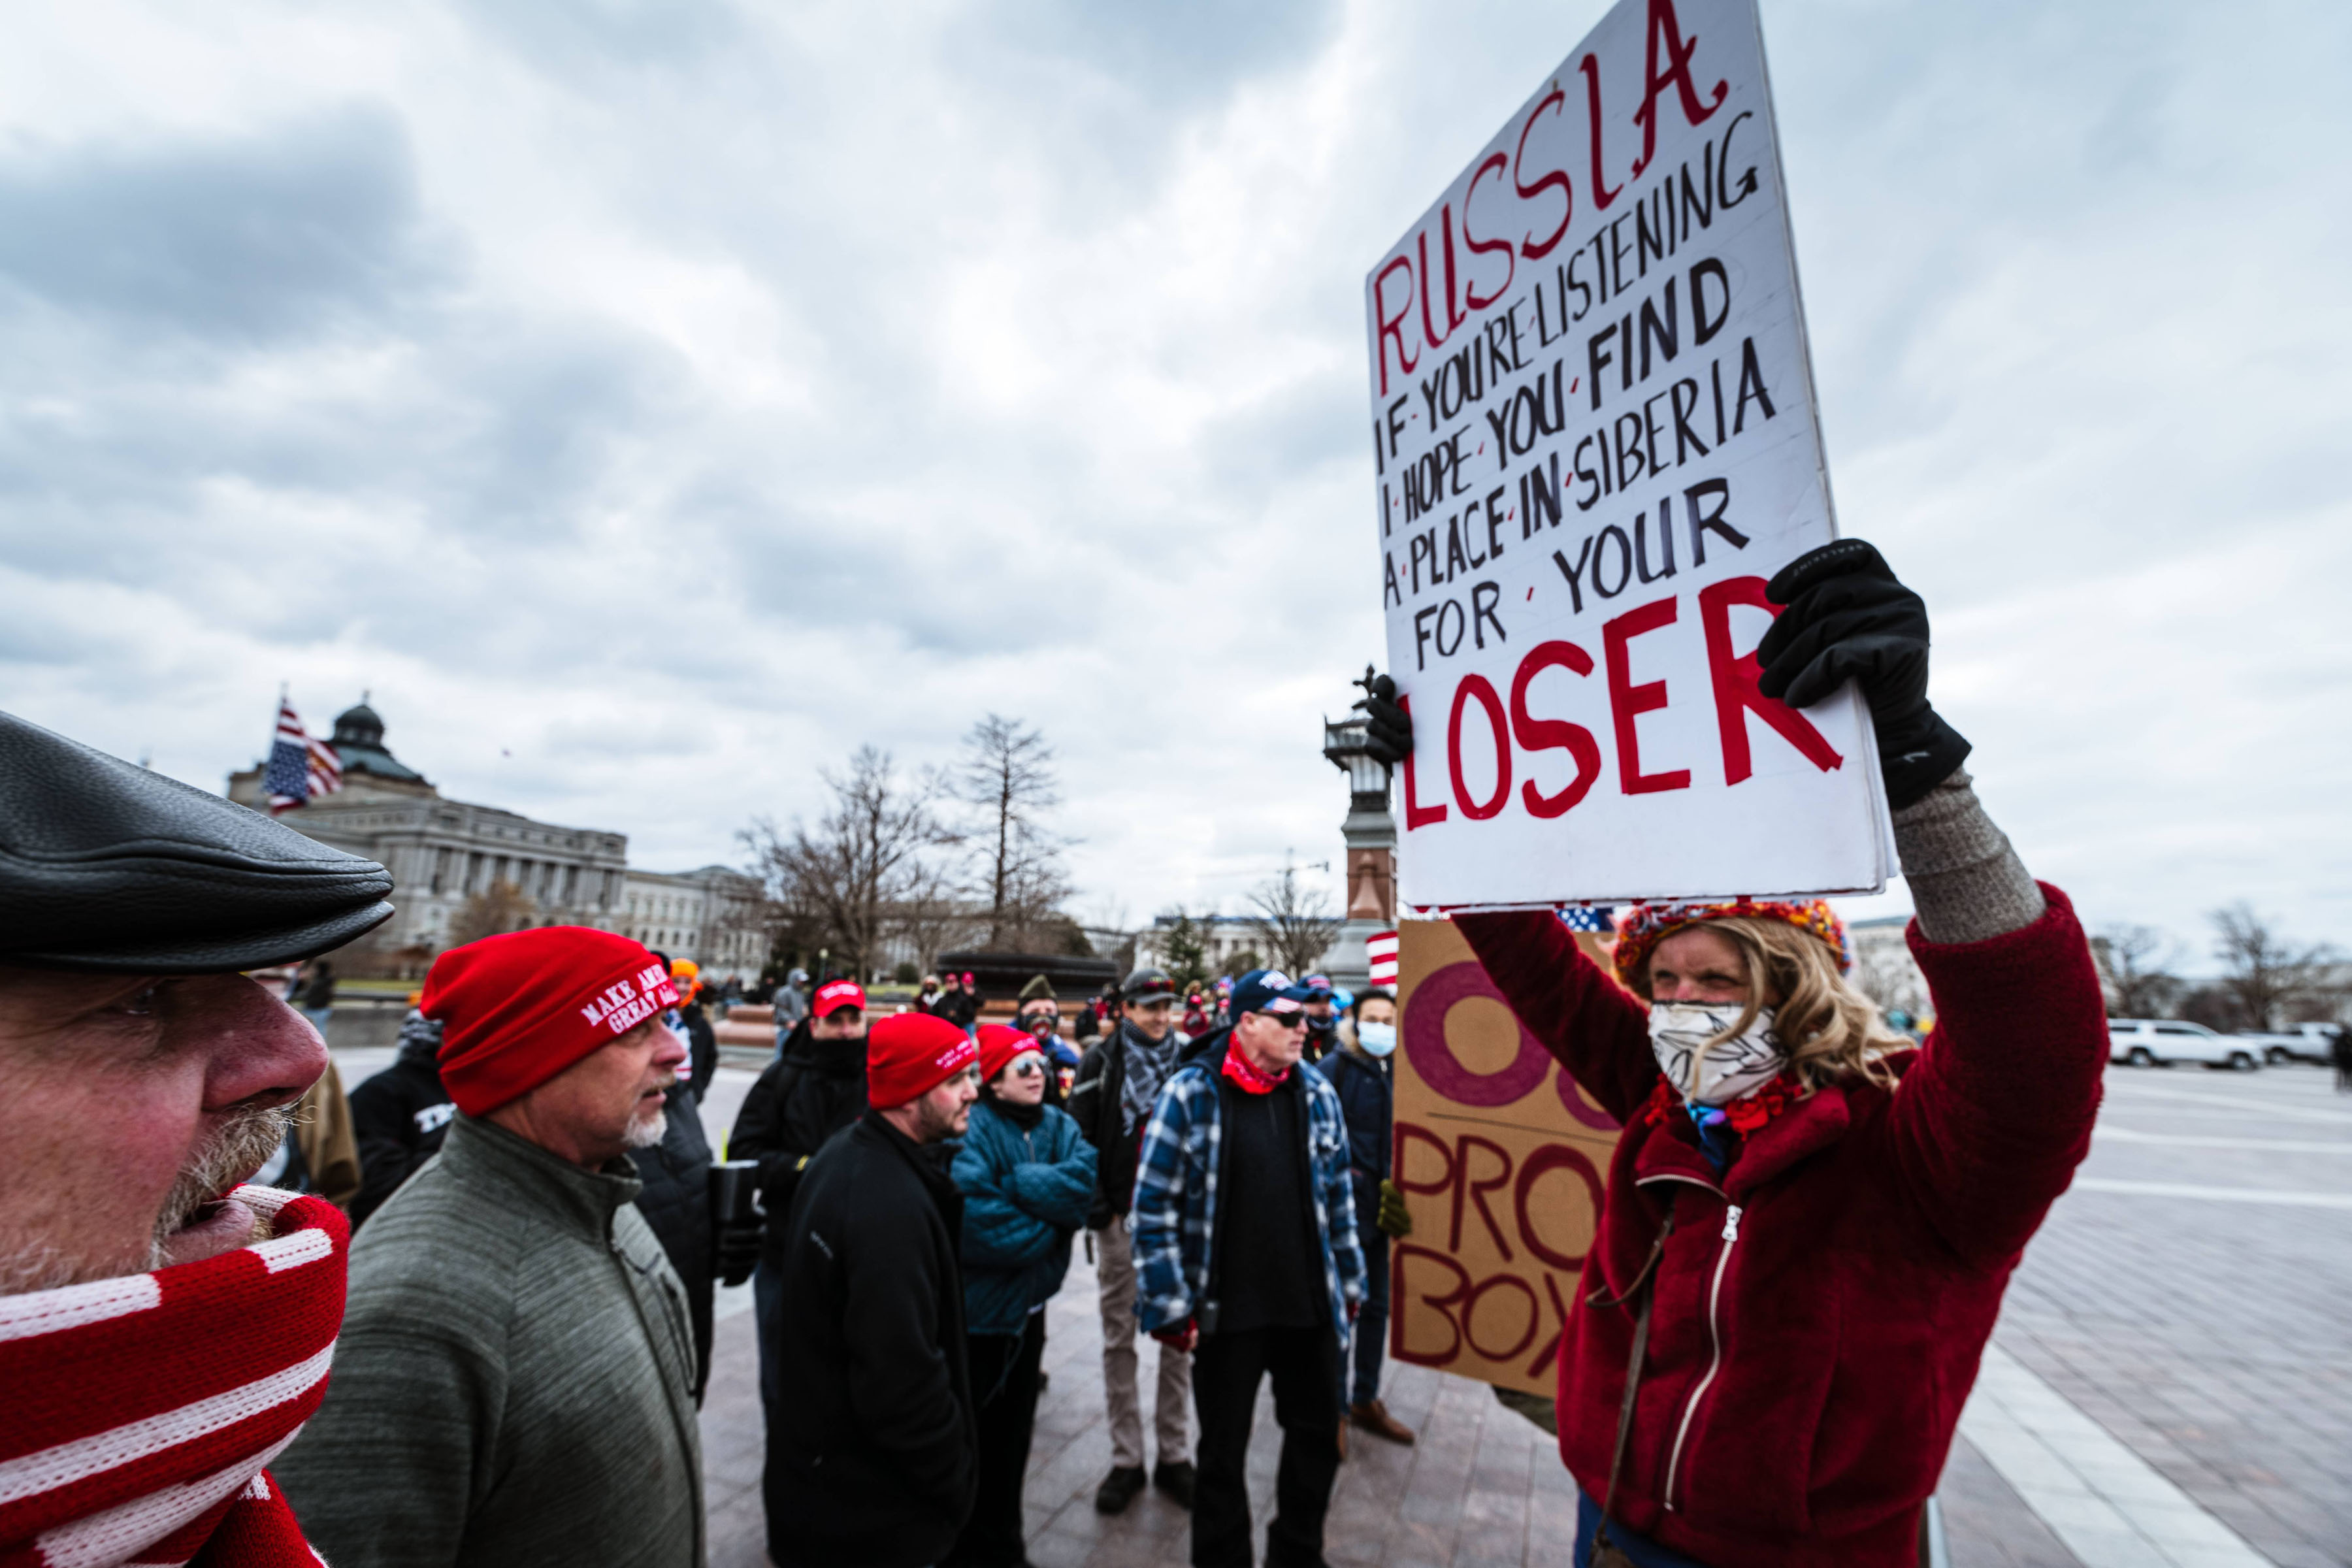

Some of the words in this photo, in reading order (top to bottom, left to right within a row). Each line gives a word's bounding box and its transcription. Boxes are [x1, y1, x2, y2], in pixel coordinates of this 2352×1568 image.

[1374, 0, 1729, 398] RUSSIA
[1375, 393, 1409, 476] IF
[1535, 110, 1759, 348] LISTENING
[1383, 483, 1392, 538] I
[1403, 424, 1472, 525] HOPE
[1485, 357, 1565, 472] YOU
[1588, 256, 1730, 412] FIND
[1384, 551, 1401, 610] A
[1409, 484, 1505, 596] PLACE
[1520, 451, 1562, 542] IN
[1573, 336, 1776, 511] SIBERIA
[1397, 576, 1844, 831] LOSER
[1414, 580, 1507, 672] FOR
[1553, 477, 1750, 615] YOUR
[580, 980, 636, 1027] MAKE
[608, 990, 659, 1034] GREAT
